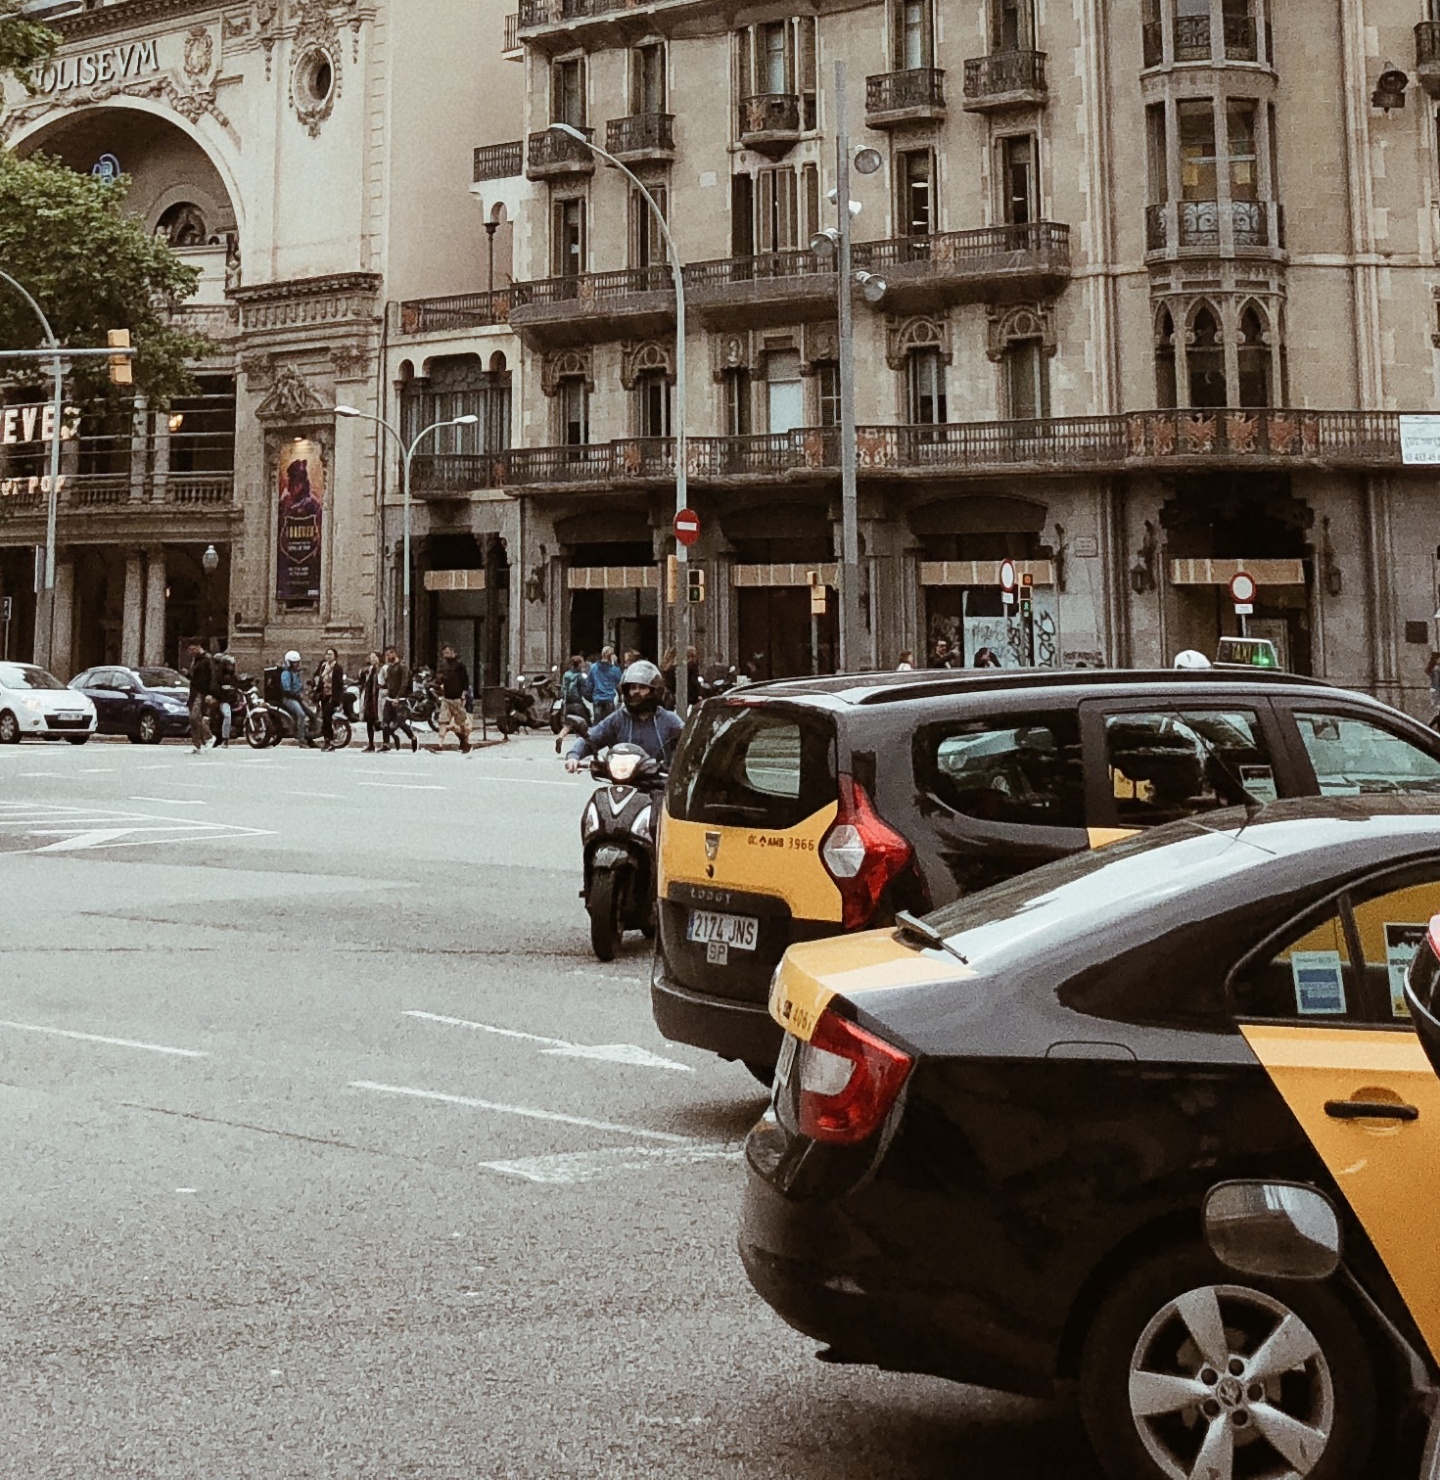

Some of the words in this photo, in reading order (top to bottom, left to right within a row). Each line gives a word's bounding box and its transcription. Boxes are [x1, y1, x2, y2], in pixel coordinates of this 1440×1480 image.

[28, 475, 66, 494] POP
[788, 837, 815, 851] 3966
[690, 887, 732, 905] LODGY
[694, 912, 724, 940] 2174
[727, 919, 755, 946] JNS
[709, 944, 727, 962] SP
